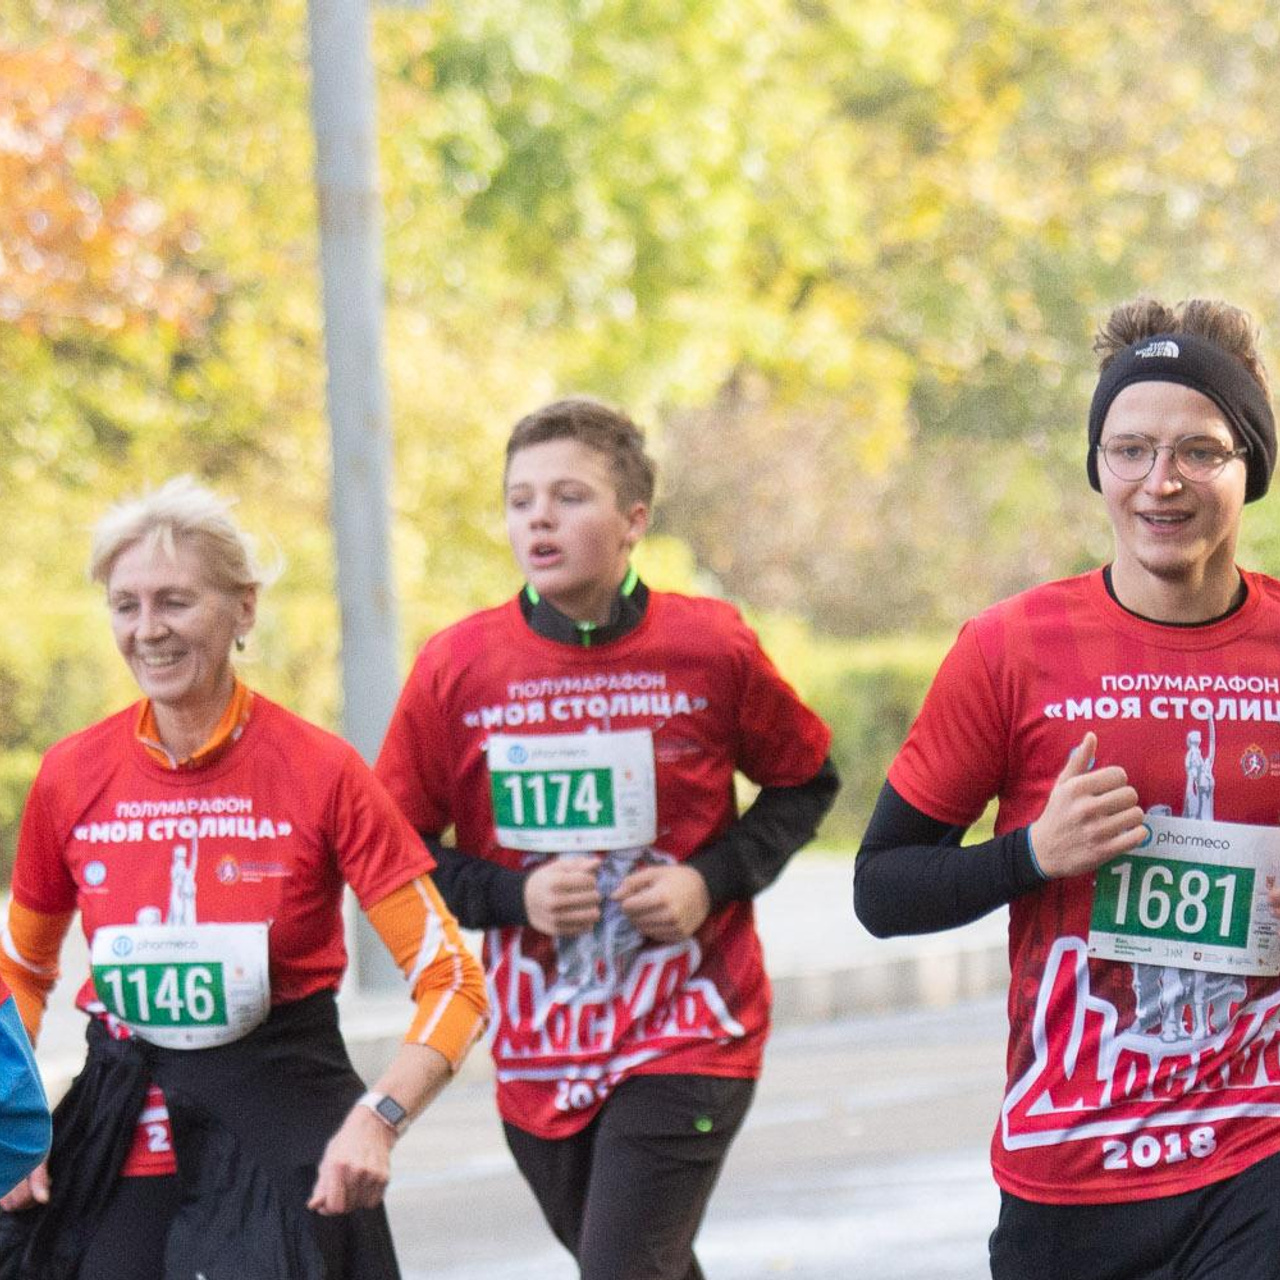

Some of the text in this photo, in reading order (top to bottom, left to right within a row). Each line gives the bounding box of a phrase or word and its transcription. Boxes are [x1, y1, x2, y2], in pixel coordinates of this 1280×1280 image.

[507, 673, 667, 699] ПОЛУМАРАФОН
[1101, 674, 1280, 693] ПОЛУМАРАФОН
[463, 693, 708, 729] «МОЯ СТОЛИЦА»
[1044, 697, 1142, 721] «МОЯ
[116, 798, 252, 819] ПОЛУМАРАФОН
[503, 772, 603, 826] 1174
[74, 816, 292, 843] «МОЯ СТОЛИЦА»
[1156, 829, 1231, 851] pharmeco
[1110, 861, 1238, 939] 1681
[102, 965, 216, 1023] 1146
[1102, 1127, 1217, 1171] 2018
